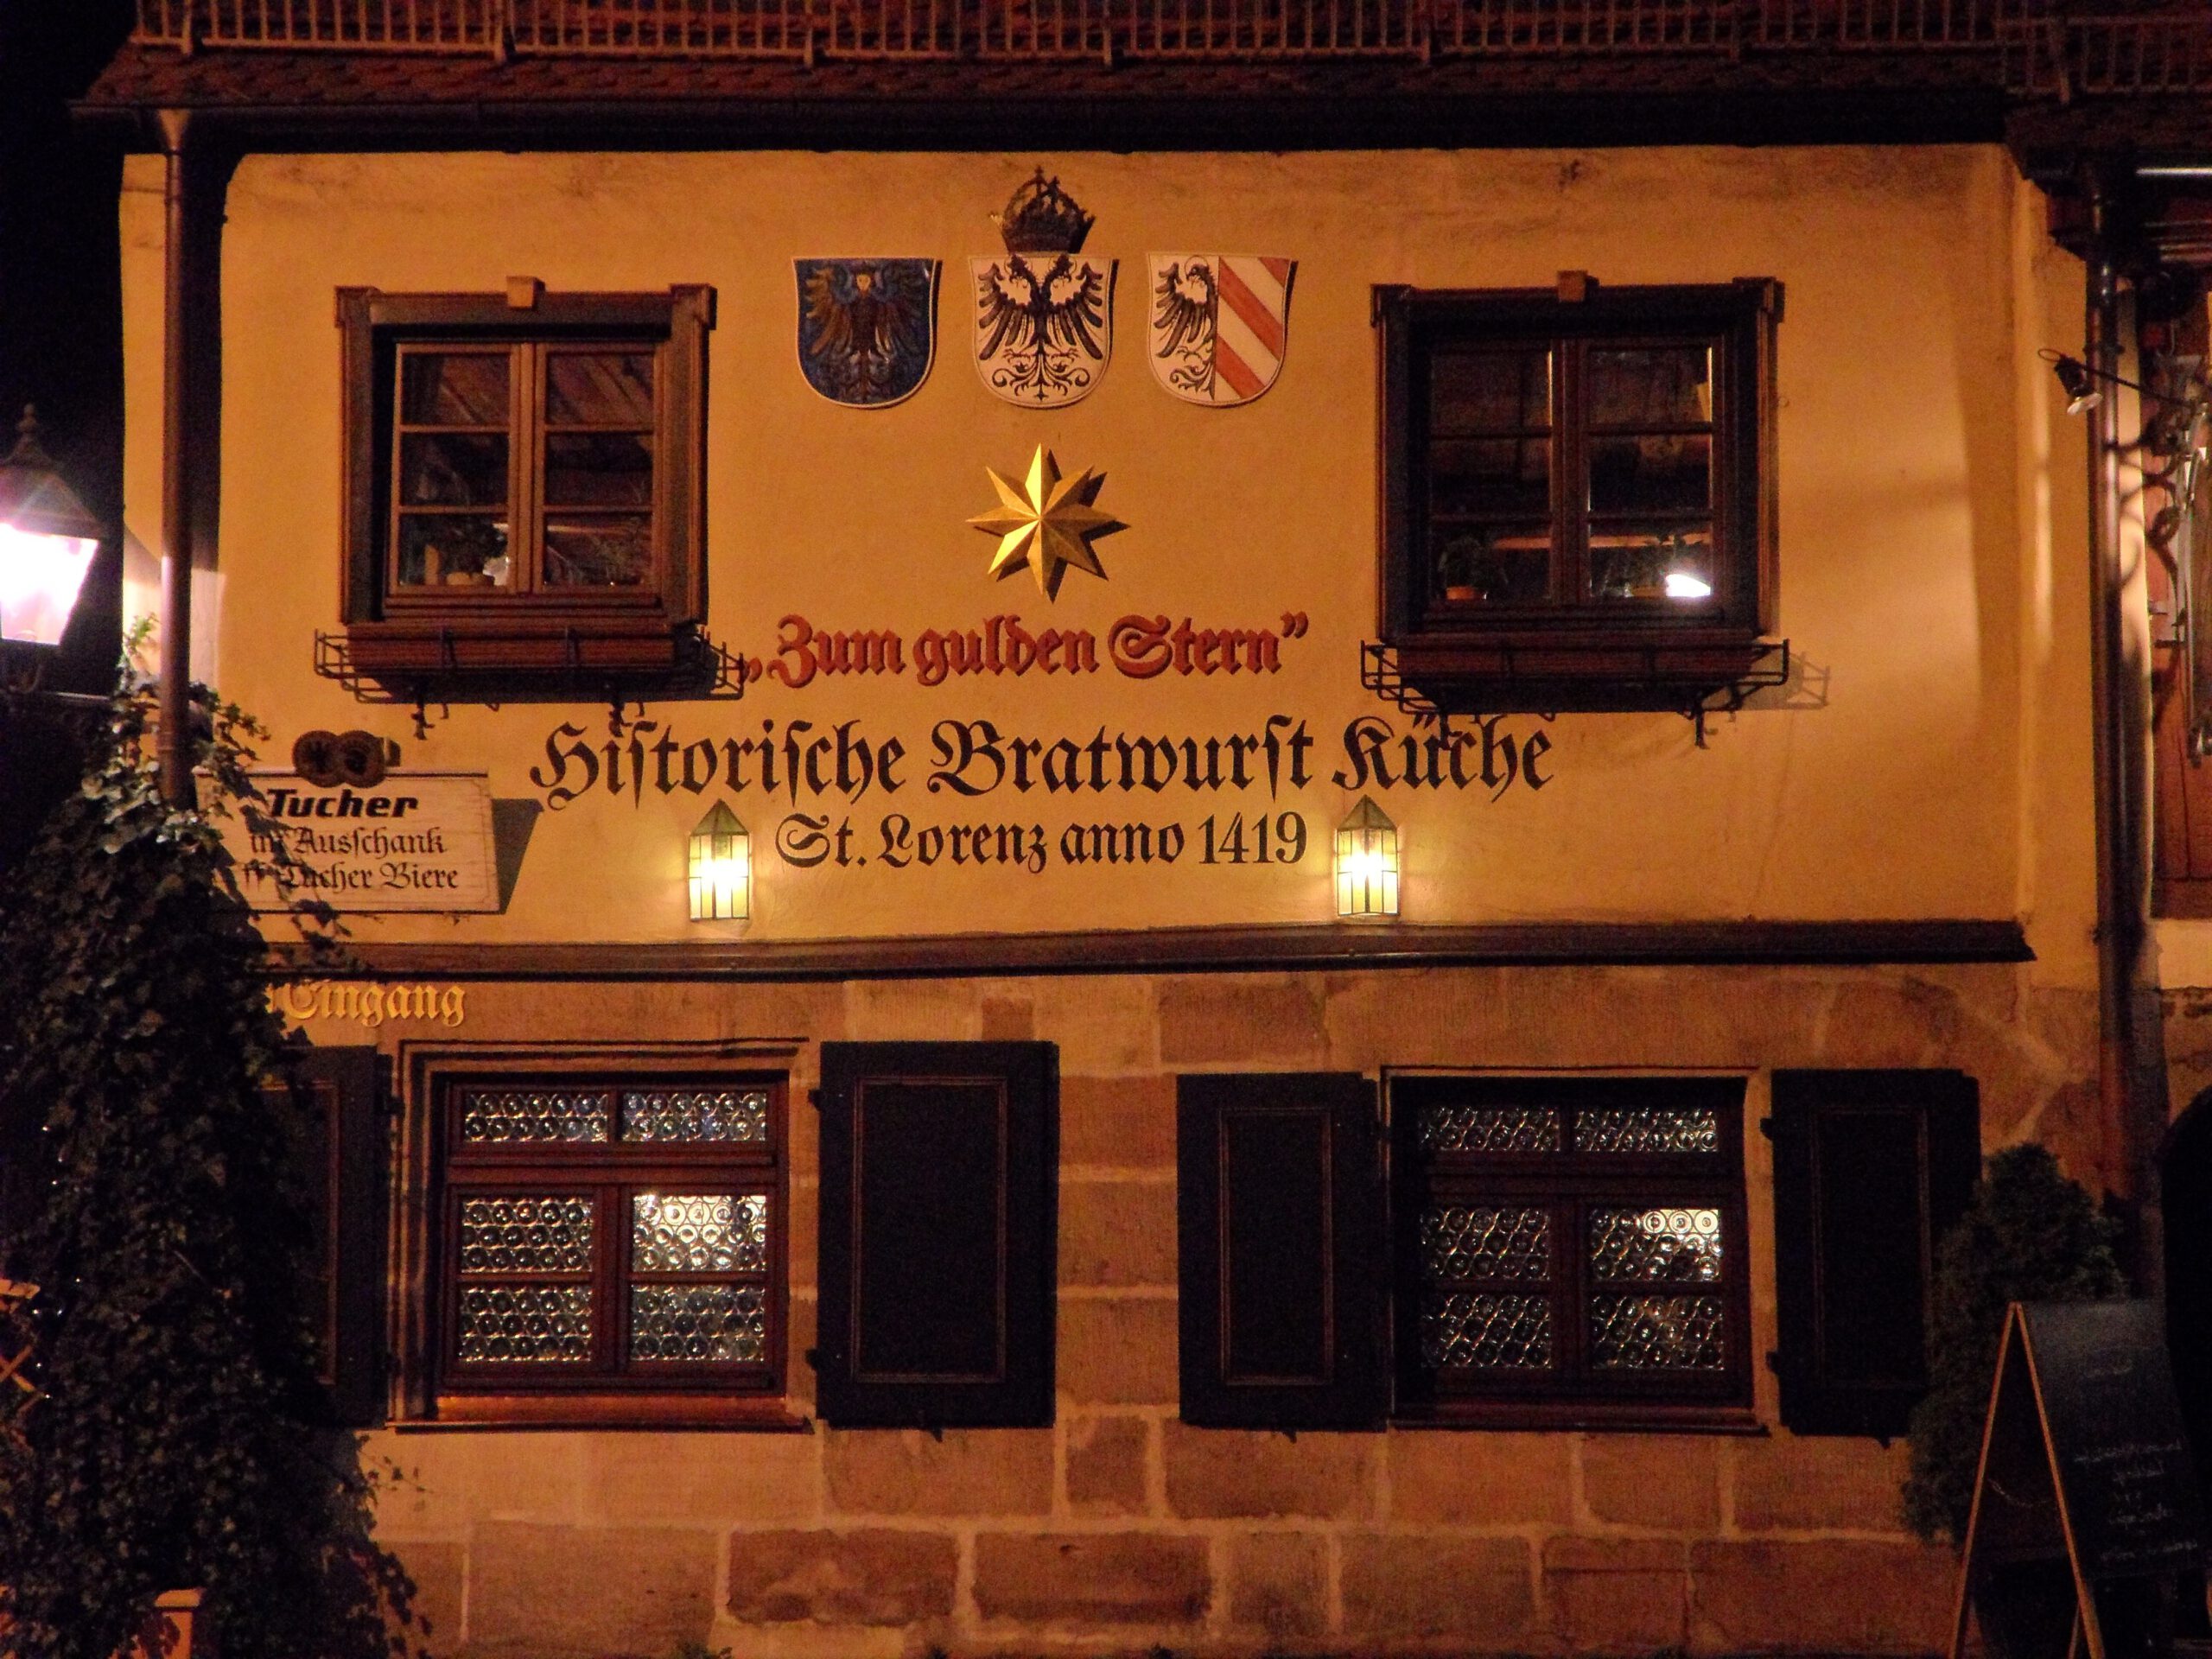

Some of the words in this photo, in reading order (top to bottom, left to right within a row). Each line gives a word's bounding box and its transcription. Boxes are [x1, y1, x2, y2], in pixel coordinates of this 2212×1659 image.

[912, 613, 1100, 687] gulden
[926, 714, 1314, 804] Bratwurst
[1331, 713, 1554, 804] Küche
[266, 788, 419, 818] Tucher
[774, 813, 867, 868] St.
[877, 813, 1048, 874] Lorenz
[1058, 817, 1185, 866] anno
[1197, 810, 1308, 866] 1419
[378, 861, 460, 890] Biere
